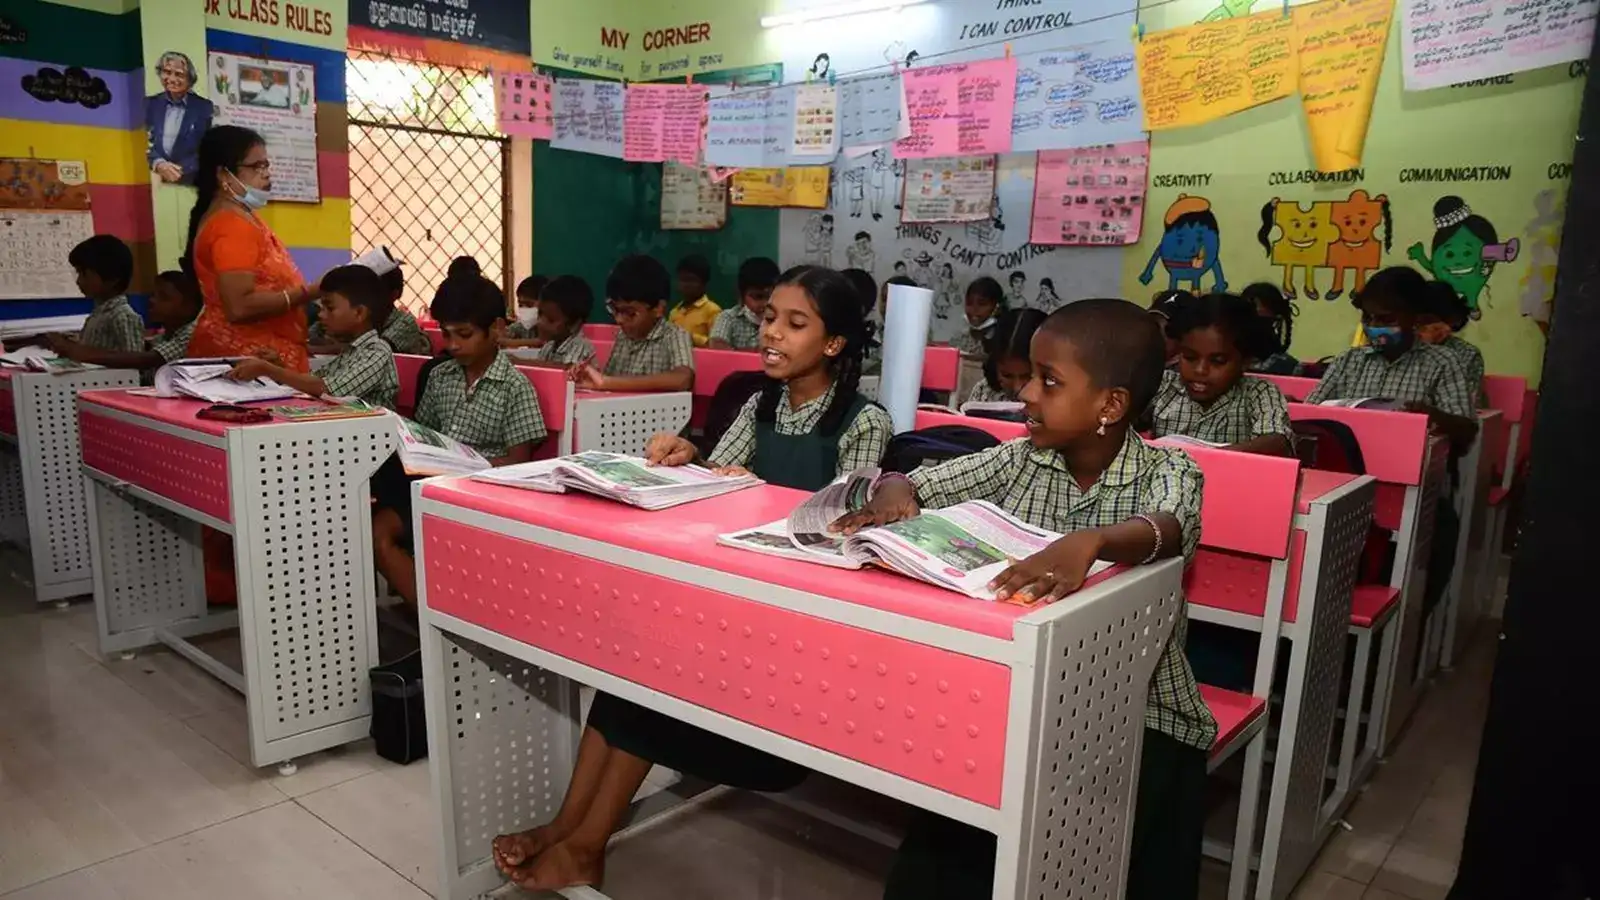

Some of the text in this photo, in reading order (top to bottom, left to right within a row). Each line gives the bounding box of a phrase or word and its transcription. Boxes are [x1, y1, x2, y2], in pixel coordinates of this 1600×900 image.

[228, 0, 280, 26] CLASS
[285, 4, 333, 36] RULES
[960, 11, 1073, 40] I CAN CONTROL
[601, 23, 711, 51] MY CORNER
[573, 54, 603, 69] yourself
[659, 55, 690, 73] personal
[1153, 172, 1213, 188] CREATIVITY
[1399, 165, 1512, 183] COMMUNICATION
[895, 224, 942, 245] THINGS
[950, 244, 986, 269] CANT
